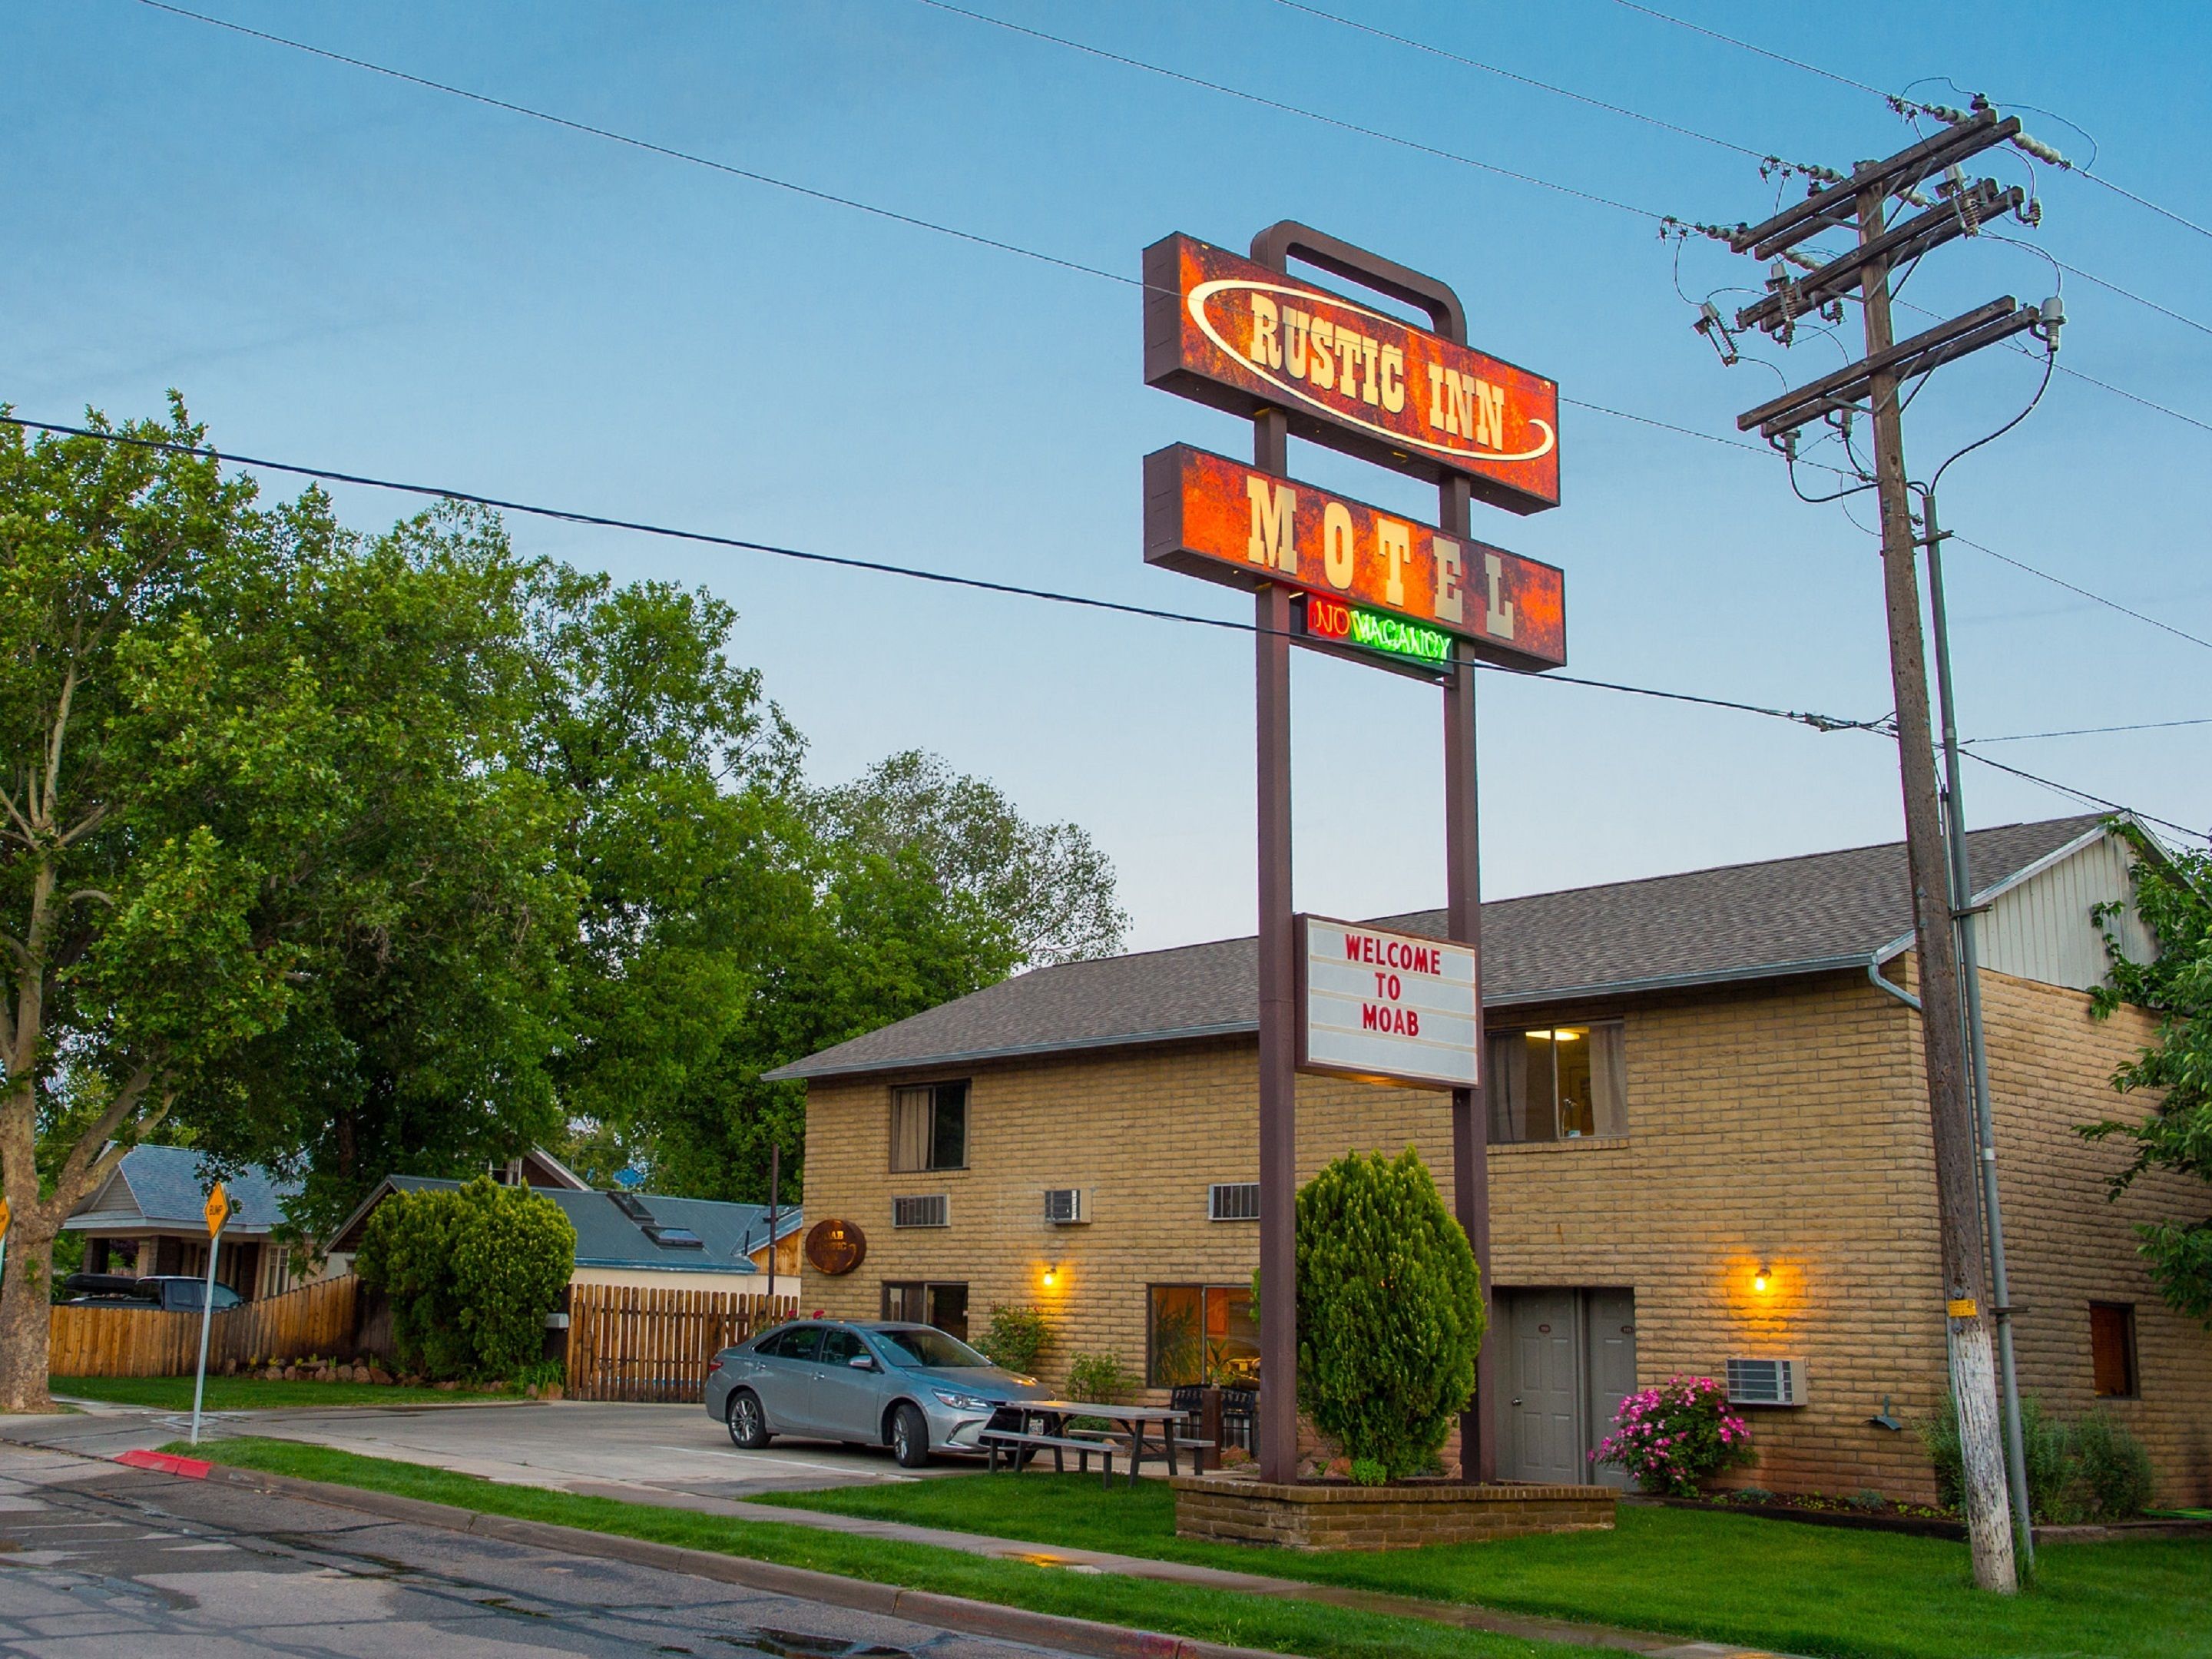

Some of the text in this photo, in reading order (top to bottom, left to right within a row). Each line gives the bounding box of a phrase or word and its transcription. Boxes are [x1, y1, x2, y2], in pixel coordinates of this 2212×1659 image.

[1250, 292, 1505, 451] RUSTIC INN
[1246, 475, 1515, 641] MOTEL
[1316, 601, 1451, 664] NO VACANCY
[1346, 933, 1441, 975] WELCOME
[1375, 972, 1401, 1001] TO
[1362, 1003, 1419, 1037] MOAB
